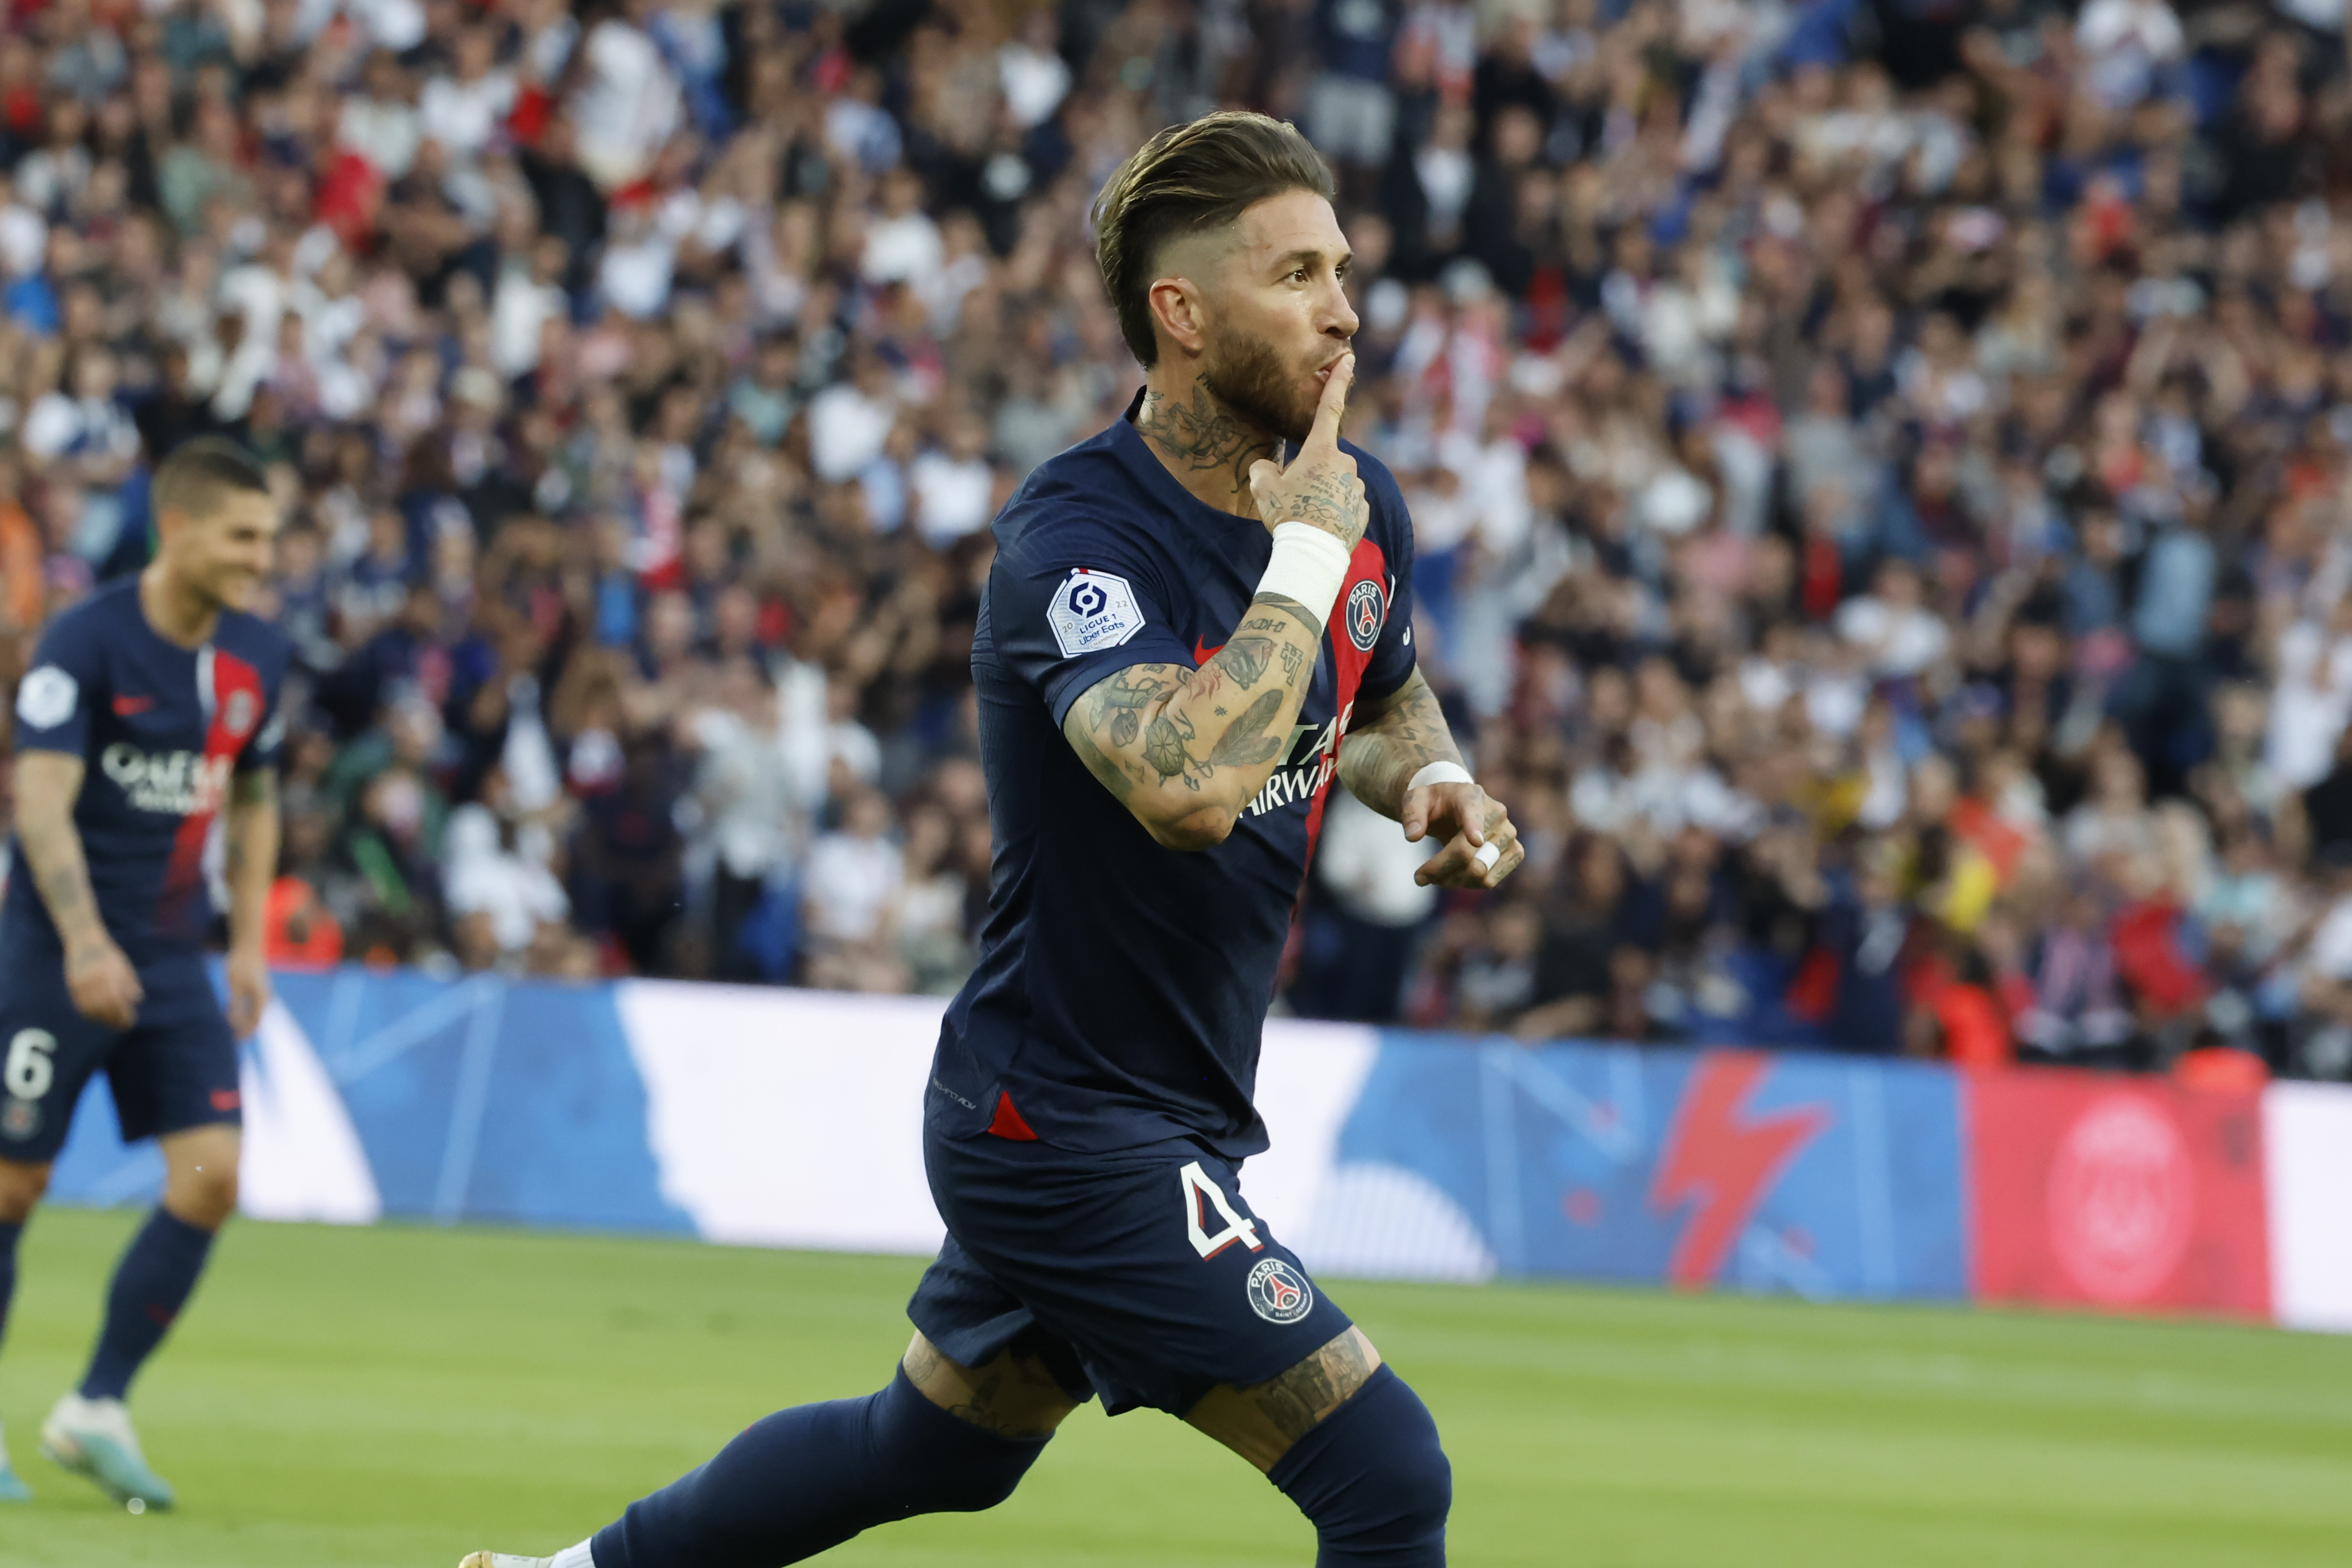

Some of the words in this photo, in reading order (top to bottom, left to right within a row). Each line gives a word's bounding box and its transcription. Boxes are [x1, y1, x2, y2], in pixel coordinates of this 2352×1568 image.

[1350, 585, 1377, 605] PARIS
[1062, 622, 1073, 633] 20
[1079, 615, 1110, 634] LIGUE
[1079, 630, 1100, 645] Uber
[1101, 622, 1125, 633] Eats
[1239, 757, 1339, 818] AIRWAY
[4, 1028, 57, 1101] 6
[1180, 1160, 1264, 1261] 4
[1251, 1262, 1284, 1288] PARIS
